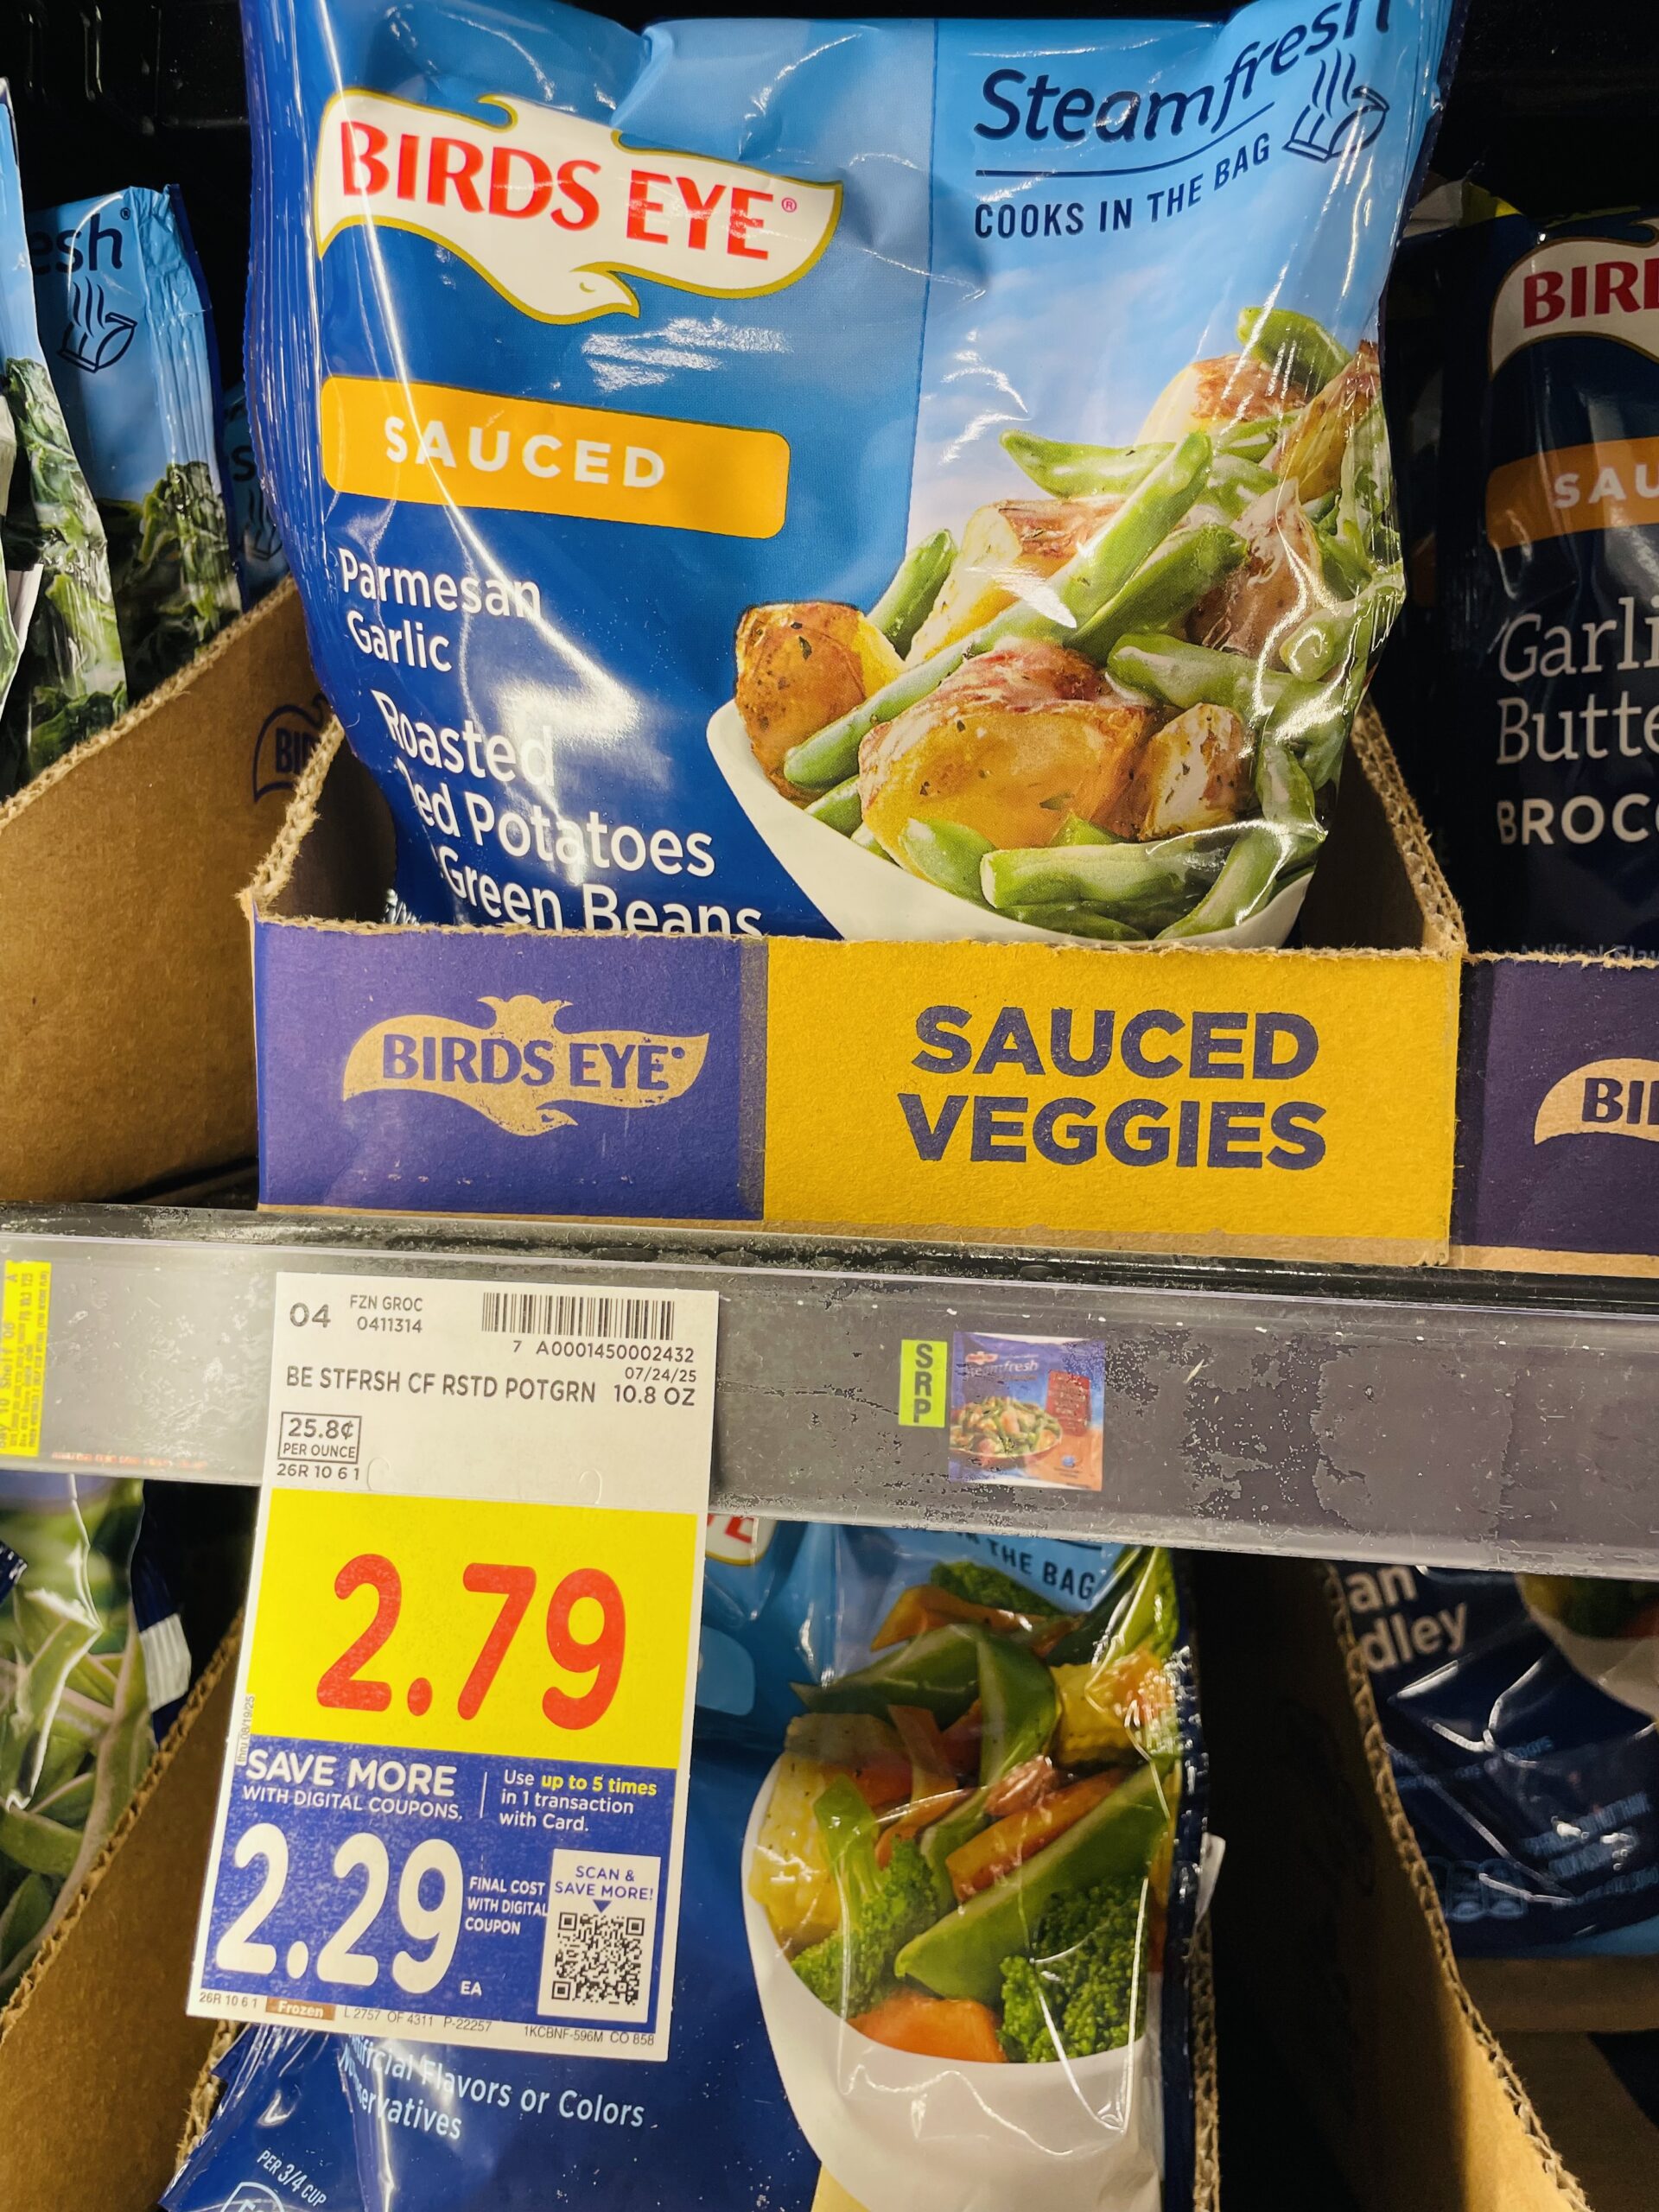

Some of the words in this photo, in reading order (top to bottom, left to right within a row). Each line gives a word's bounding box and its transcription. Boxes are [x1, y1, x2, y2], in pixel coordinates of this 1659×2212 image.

[974, 0, 1390, 143] Steamfresh
[339, 119, 602, 232] BIRDS
[974, 200, 1085, 238] COOKS
[1098, 198, 1134, 232] IN
[1147, 174, 1202, 222] THE
[1214, 133, 1270, 191] BAG
[383, 415, 666, 488] SAUCED
[337, 546, 542, 620] Parmesan
[346, 609, 454, 672] Garlic
[370, 689, 556, 787] Roasted
[463, 790, 716, 880] Potatoes
[1496, 793, 1659, 845] BROC
[437, 845, 564, 931] Green
[582, 882, 763, 937] Beans
[382, 1033, 556, 1087] BIRDS
[912, 1004, 1319, 1080] SAUCED
[897, 1092, 1327, 1170] VEGGIES
[289, 1302, 332, 1328] 04
[349, 1294, 378, 1310] FZN
[382, 1296, 424, 1313] GROC
[357, 1316, 423, 1333] 0411314
[512, 1340, 523, 1353] 7
[536, 1341, 695, 1363] A0001450002432
[285, 1365, 314, 1388] BE
[319, 1367, 401, 1393] STFRSH
[407, 1372, 436, 1395] CF
[442, 1374, 499, 1398] RSTD
[505, 1377, 596, 1403] POTGRN
[613, 1383, 657, 1405] 10.8
[664, 1386, 696, 1407] OZ
[625, 1366, 697, 1383] 07/24/25
[288, 1417, 354, 1440] 25.8¢
[283, 1442, 308, 1456] PER
[310, 1444, 357, 1459] OUNCE
[276, 1463, 309, 1478] 26R
[315, 1465, 333, 1479] 10
[337, 1465, 348, 1480] 6
[353, 1467, 360, 1481] 1
[986, 1537, 1033, 1575] THE
[1042, 1560, 1096, 1600] BAG
[316, 1553, 627, 1731] 2.79
[245, 1748, 338, 1787] SAVE
[347, 1757, 458, 1797] MORE
[504, 1769, 536, 1786] Use
[540, 1774, 564, 1791] up
[569, 1775, 588, 1791] to
[592, 1777, 604, 1791] 5
[608, 1777, 658, 1796] times
[242, 1784, 289, 1804] WITH
[293, 1789, 363, 1811] DIGITAL
[368, 1796, 464, 1821] COUPONS.
[499, 1811, 537, 1827] with
[542, 1813, 590, 1832] Card.
[500, 1789, 518, 1805] in
[522, 1789, 530, 1807] 1
[534, 1792, 635, 1815] transaction
[468, 1876, 508, 1892] FINAL
[510, 1879, 546, 1896] COST
[554, 1880, 595, 1897] SAVE
[601, 1885, 655, 1901] MORE!
[575, 1865, 620, 1881] SCAN
[625, 1868, 636, 1883] &
[215, 1821, 465, 1995] 2.29
[465, 1916, 522, 1936] COUPON
[467, 1896, 500, 1912] WITH
[501, 1899, 549, 1917] DIGITAL
[198, 1991, 222, 2005] 26R
[226, 1993, 239, 2007] 10
[242, 1995, 250, 2008] 6
[252, 1997, 259, 2010] 1
[277, 1999, 325, 2019] Frozen
[460, 1980, 484, 1997] EA
[353, 2006, 382, 2022] 2757
[386, 2011, 406, 2024] OF
[406, 2012, 435, 2027] 4311
[442, 2016, 493, 2033] P-22257
[524, 2024, 605, 2044] 1KCBNF-596M
[608, 2031, 630, 2045] CO
[632, 2033, 656, 2047] 858
[421, 2054, 512, 2108] Flavors
[520, 2088, 550, 2114] or
[557, 2088, 645, 2128] Colors
[256, 2149, 283, 2177] PER
[276, 2163, 308, 2194] 3/4
[300, 2183, 327, 2208] CUP
